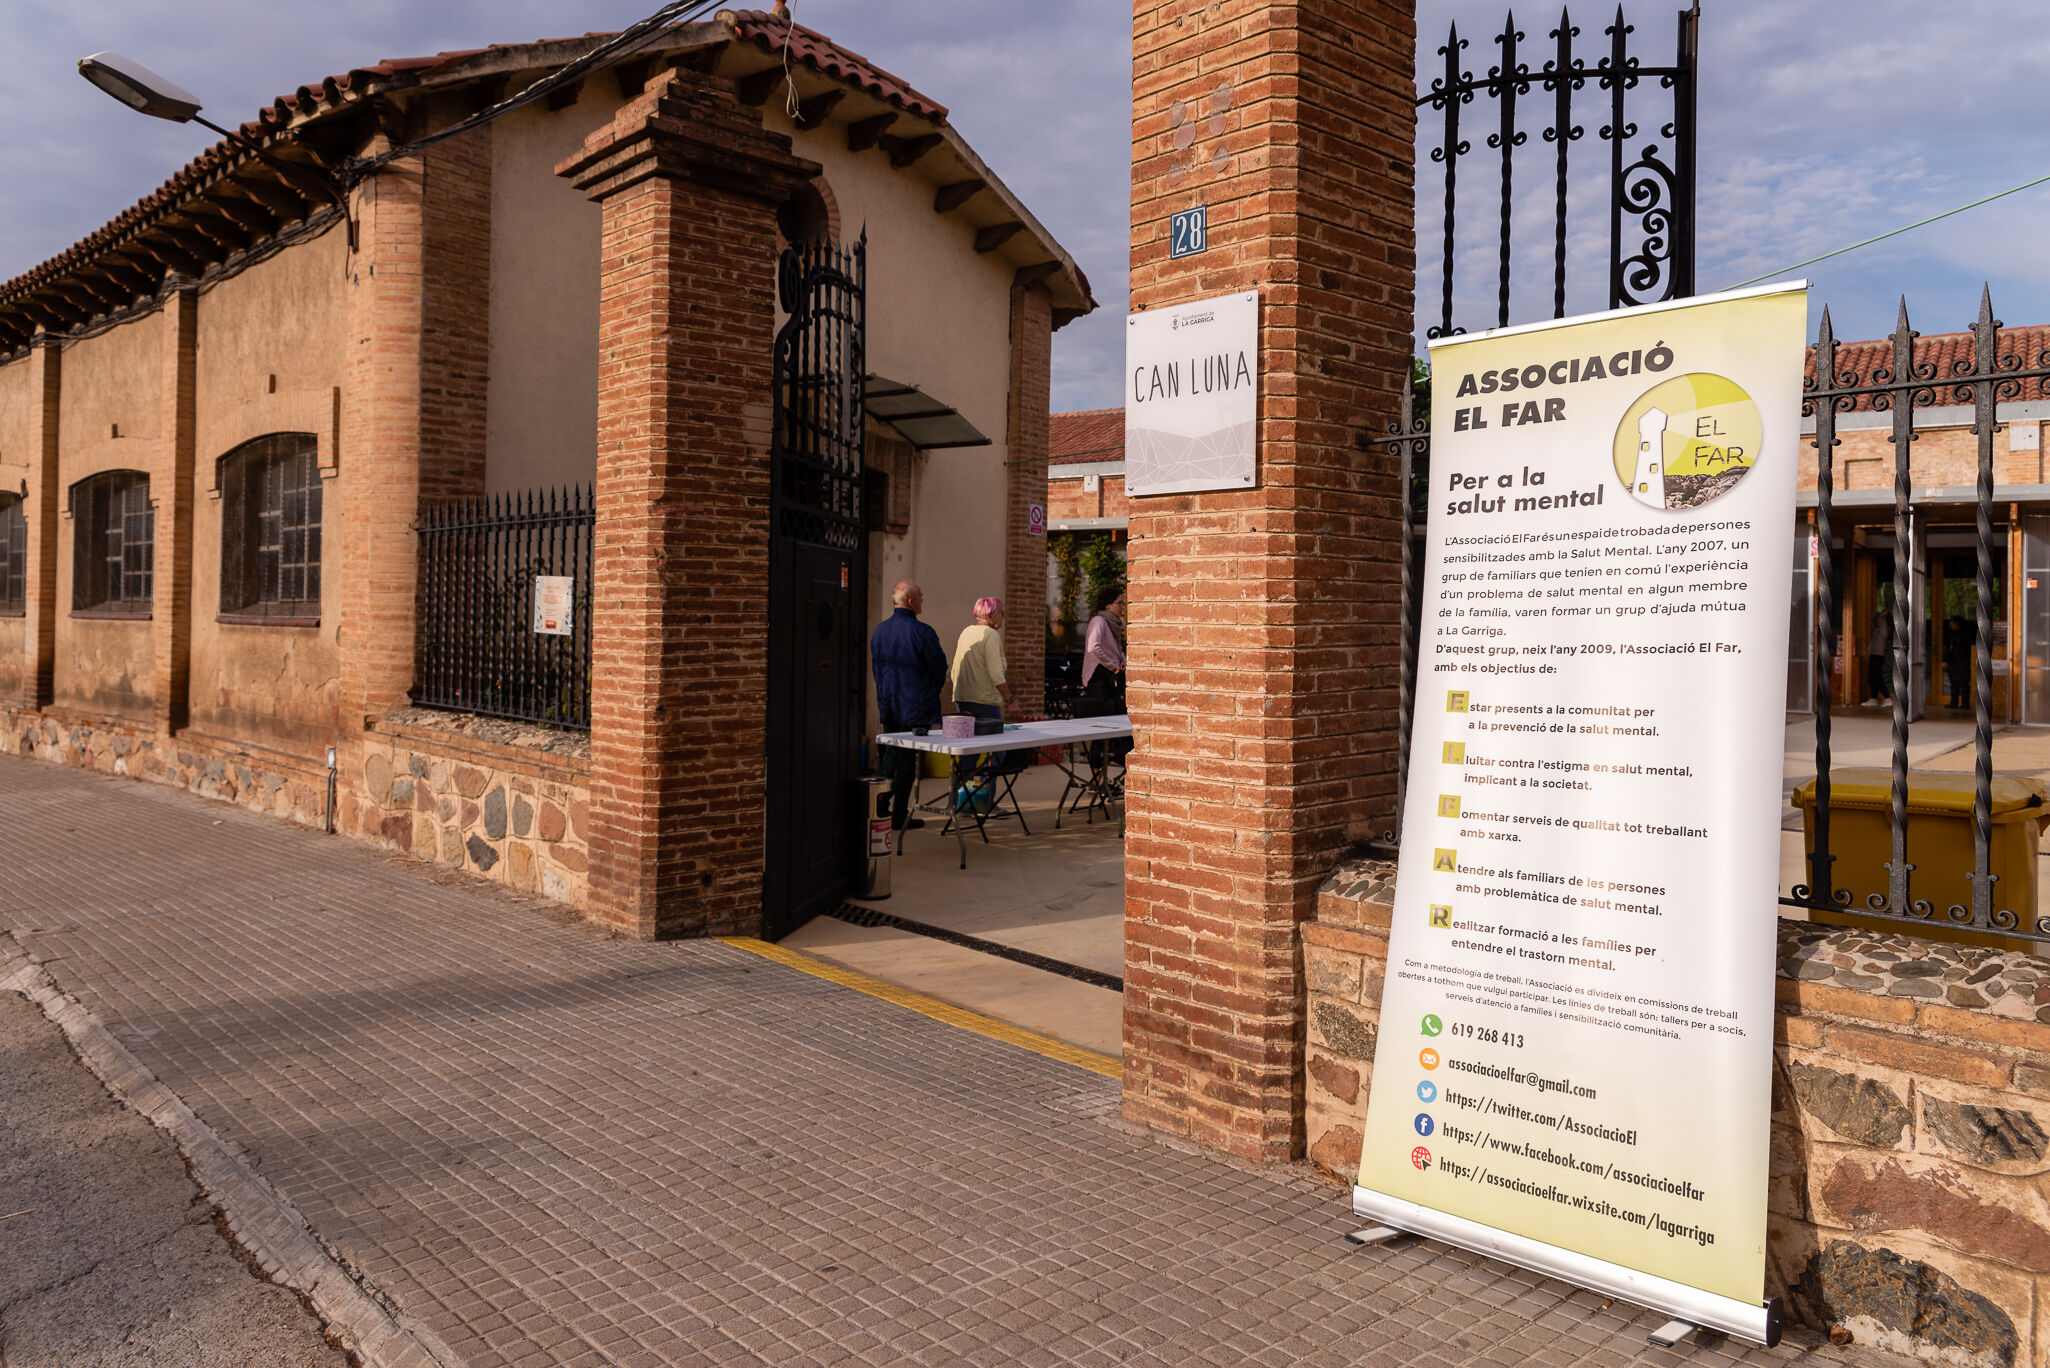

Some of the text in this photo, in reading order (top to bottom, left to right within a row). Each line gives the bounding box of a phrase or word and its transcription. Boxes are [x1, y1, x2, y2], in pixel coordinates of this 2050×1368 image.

[1175, 212, 1202, 254] 28
[1190, 316, 1214, 326] GARRIGA
[1134, 350, 1251, 402] CAN LUNA
[1456, 340, 1674, 398] ASSOCIACIÓ
[1454, 397, 1566, 432] EL FAR
[1696, 416, 1726, 437] EL
[1694, 446, 1744, 467] FAR
[1449, 466, 1545, 492] Per a la
[1446, 484, 1604, 516] salut mental
[1445, 521, 1751, 546] L'Associació Far espai trobada persones
[1443, 552, 1526, 564] sensibilitzades
[1528, 550, 1555, 561] amb
[1558, 550, 1568, 560] la
[1571, 548, 1601, 559] Salut
[1604, 545, 1652, 557] Mental.
[1656, 544, 1688, 556] L'any
[1731, 541, 1750, 550] un
[1441, 559, 1749, 584] grup de familiars que tenien en comú l'experiència
[1440, 580, 1748, 601] d'un problema de salut mental en algun membre
[1438, 601, 1746, 618] de la família, varen formar un grup d'ajuda mútua
[1437, 625, 1507, 638] a La Garriga.
[1436, 642, 1742, 657] D'aquest grup, neix l'any 2009, l'Associació El Far,
[1434, 662, 1557, 676] amb els objectius de:
[1494, 705, 1544, 715] presents
[1546, 706, 1553, 715] a
[1555, 704, 1566, 715] la
[1568, 705, 1631, 717] comunitat
[1634, 709, 1655, 719] per
[1468, 720, 1660, 737] a la prevenció de la salut mental.
[1498, 759, 1535, 769] contra
[1537, 759, 1590, 773] l'estigma
[1593, 764, 1609, 773] en
[1611, 763, 1643, 775] salut
[1645, 766, 1693, 778] mental,
[1464, 773, 1593, 791] implicant a la societat.
[1460, 828, 1522, 843] amb xarxa.
[1512, 815, 1552, 826] serveis
[1554, 816, 1570, 828] de
[1572, 819, 1621, 832] qualitat
[1623, 822, 1643, 834] tot
[1645, 824, 1708, 838] treballant
[1498, 868, 1514, 879] als
[1516, 869, 1566, 885] familiars
[1568, 875, 1584, 887] de
[1587, 877, 1605, 889] les
[1608, 882, 1666, 896] persones
[1455, 884, 1663, 916] amb problemàtica de salut mental.
[1498, 924, 1549, 942] formació
[1551, 934, 1559, 943] a
[1561, 933, 1579, 946] les
[1635, 946, 1657, 957] per
[1451, 939, 1616, 971] entendre el trastorn mental.
[1397, 971, 1426, 982] obertes
[1434, 977, 1465, 988] tothom
[1483, 986, 1508, 996] vulgui
[1509, 990, 1551, 1003] participar.
[1608, 1005, 1637, 1018] treball
[1639, 1011, 1659, 1022] són:
[1661, 1014, 1689, 1027] tallers
[1404, 958, 1422, 968] Com
[1430, 964, 1482, 978] metodologia
[1525, 978, 1573, 993] l'Associació
[1586, 988, 1622, 1001] divideix
[1638, 998, 1689, 1012] comissions
[1705, 1007, 1738, 1020] treball
[1445, 992, 1474, 1003] serveis
[1475, 997, 1512, 1010] d'atenció
[1559, 1012, 1622, 1029] sensibilització
[1623, 1024, 1681, 1040] comunitària.
[1451, 1022, 1524, 1049] 619 268 413
[1448, 1059, 1597, 1100] associacioelfar@gmail.com
[1445, 1088, 1637, 1146] https://twitter.com/AssociacioEl
[1442, 1122, 1705, 1202] https://www.facebook.com/associacioelfar
[1440, 1156, 1715, 1246] https://associacioelfar.wixsite.com/lagarriga
